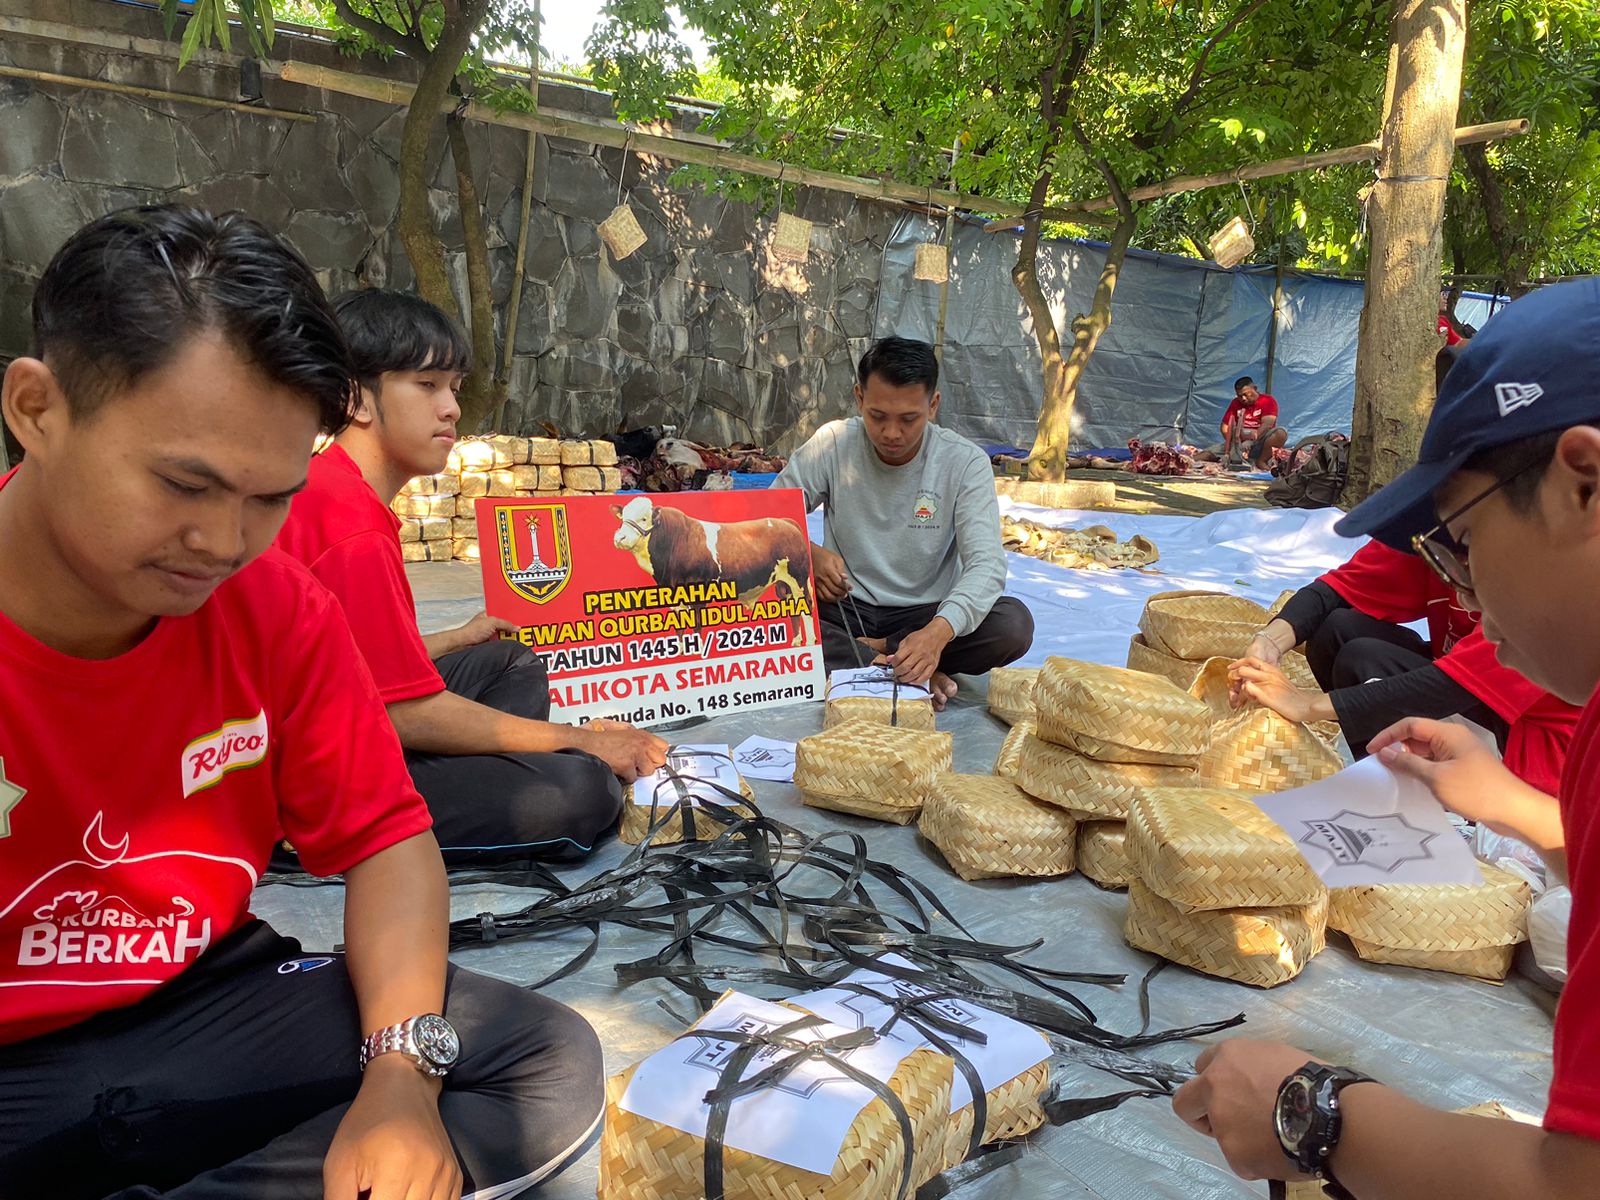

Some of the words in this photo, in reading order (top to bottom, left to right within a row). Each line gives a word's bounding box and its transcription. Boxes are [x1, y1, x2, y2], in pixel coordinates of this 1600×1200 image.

[585, 581, 737, 614] PENYERAHAN
[599, 609, 696, 638] QURBAN
[700, 604, 749, 627] IDUL
[751, 598, 811, 621] ADHA
[537, 644, 622, 672] TAHUN
[628, 637, 680, 661] 1445
[683, 635, 700, 654] H
[702, 633, 713, 657] /
[717, 627, 765, 650] 2024
[769, 624, 787, 643] M
[548, 673, 671, 709] ALIKOTA
[675, 652, 814, 691] SEMARANG
[578, 706, 656, 727] Pmuda
[660, 702, 692, 719] No.
[697, 693, 729, 712] 148
[732, 683, 815, 707] Semarang
[61, 908, 176, 929] KURBAN
[16, 916, 212, 967] BERKAH
[704, 1020, 756, 1063] MJT
